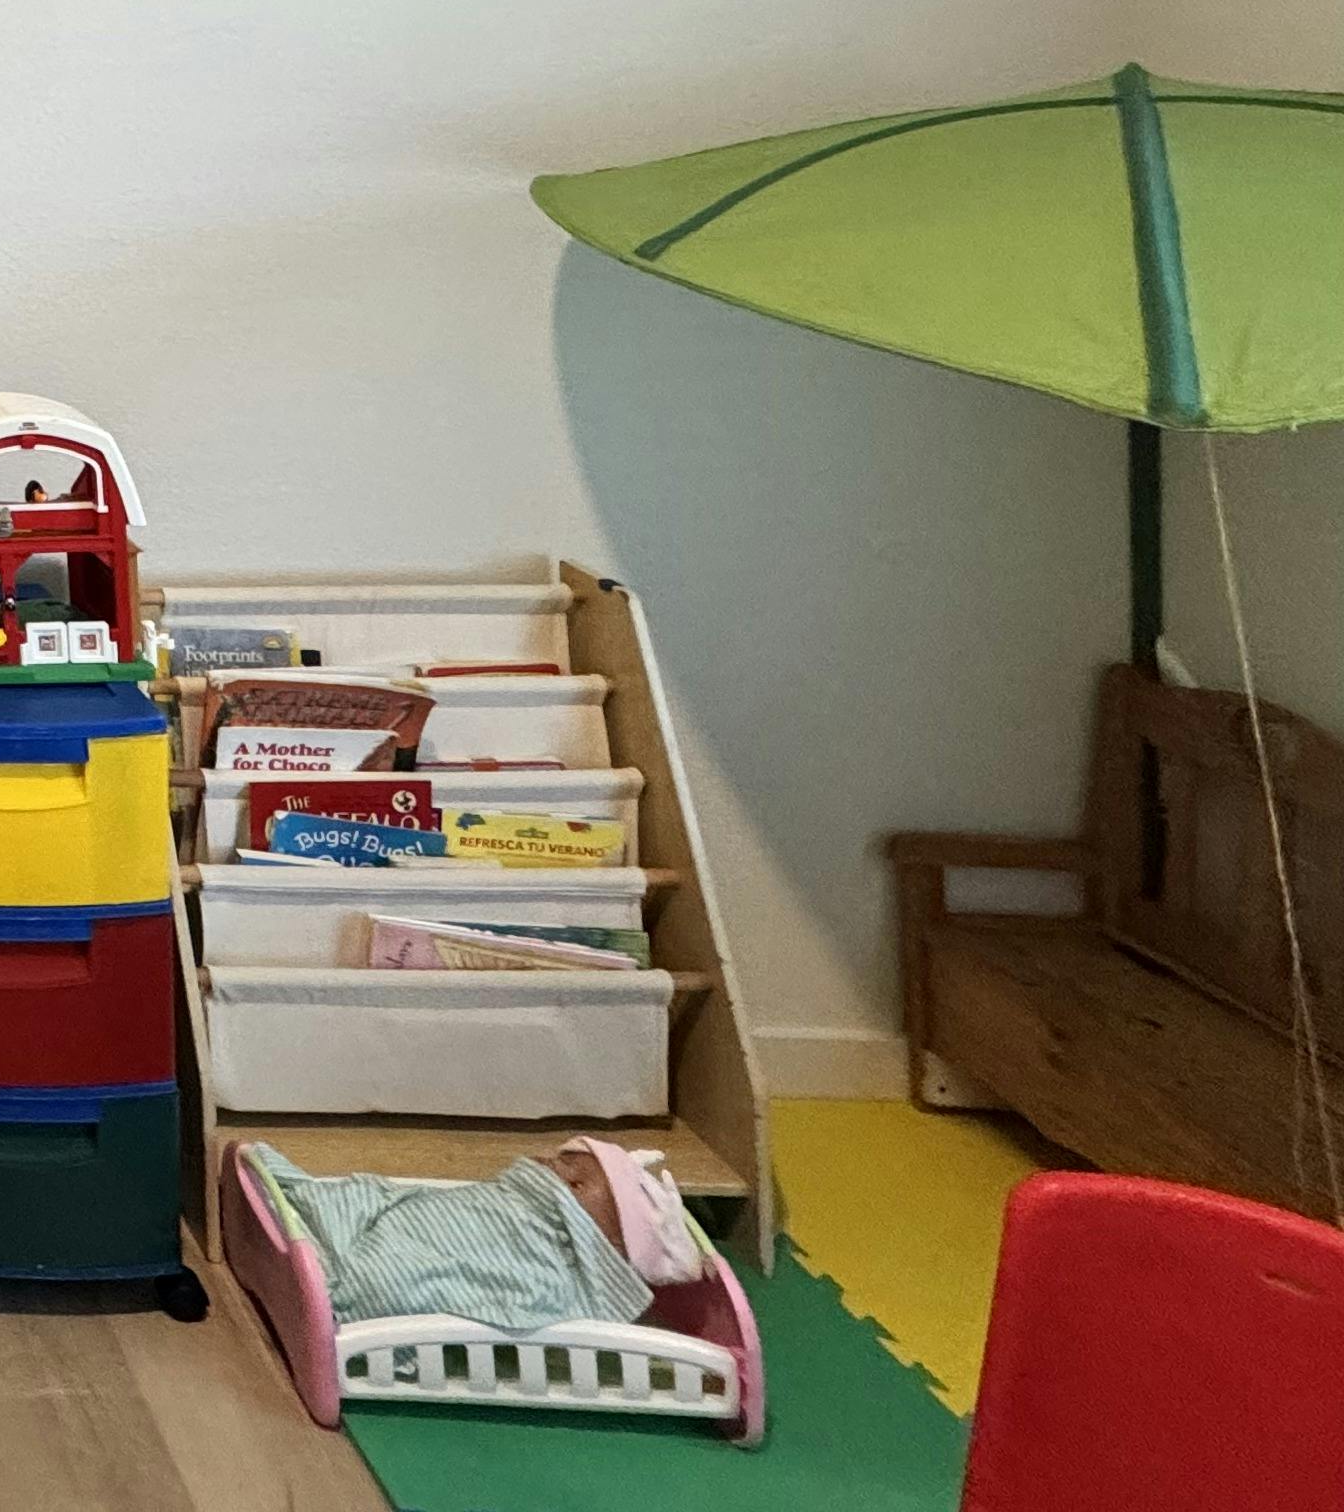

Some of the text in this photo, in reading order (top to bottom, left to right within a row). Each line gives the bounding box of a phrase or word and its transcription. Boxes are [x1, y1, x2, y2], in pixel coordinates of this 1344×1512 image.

[184, 644, 264, 666] Footprints
[235, 743, 335, 757] A Mother
[233, 758, 332, 771] for Choco
[281, 795, 311, 811] THE
[294, 830, 359, 851] Bugs!
[459, 837, 605, 858] REFRESCA TU VERANO
